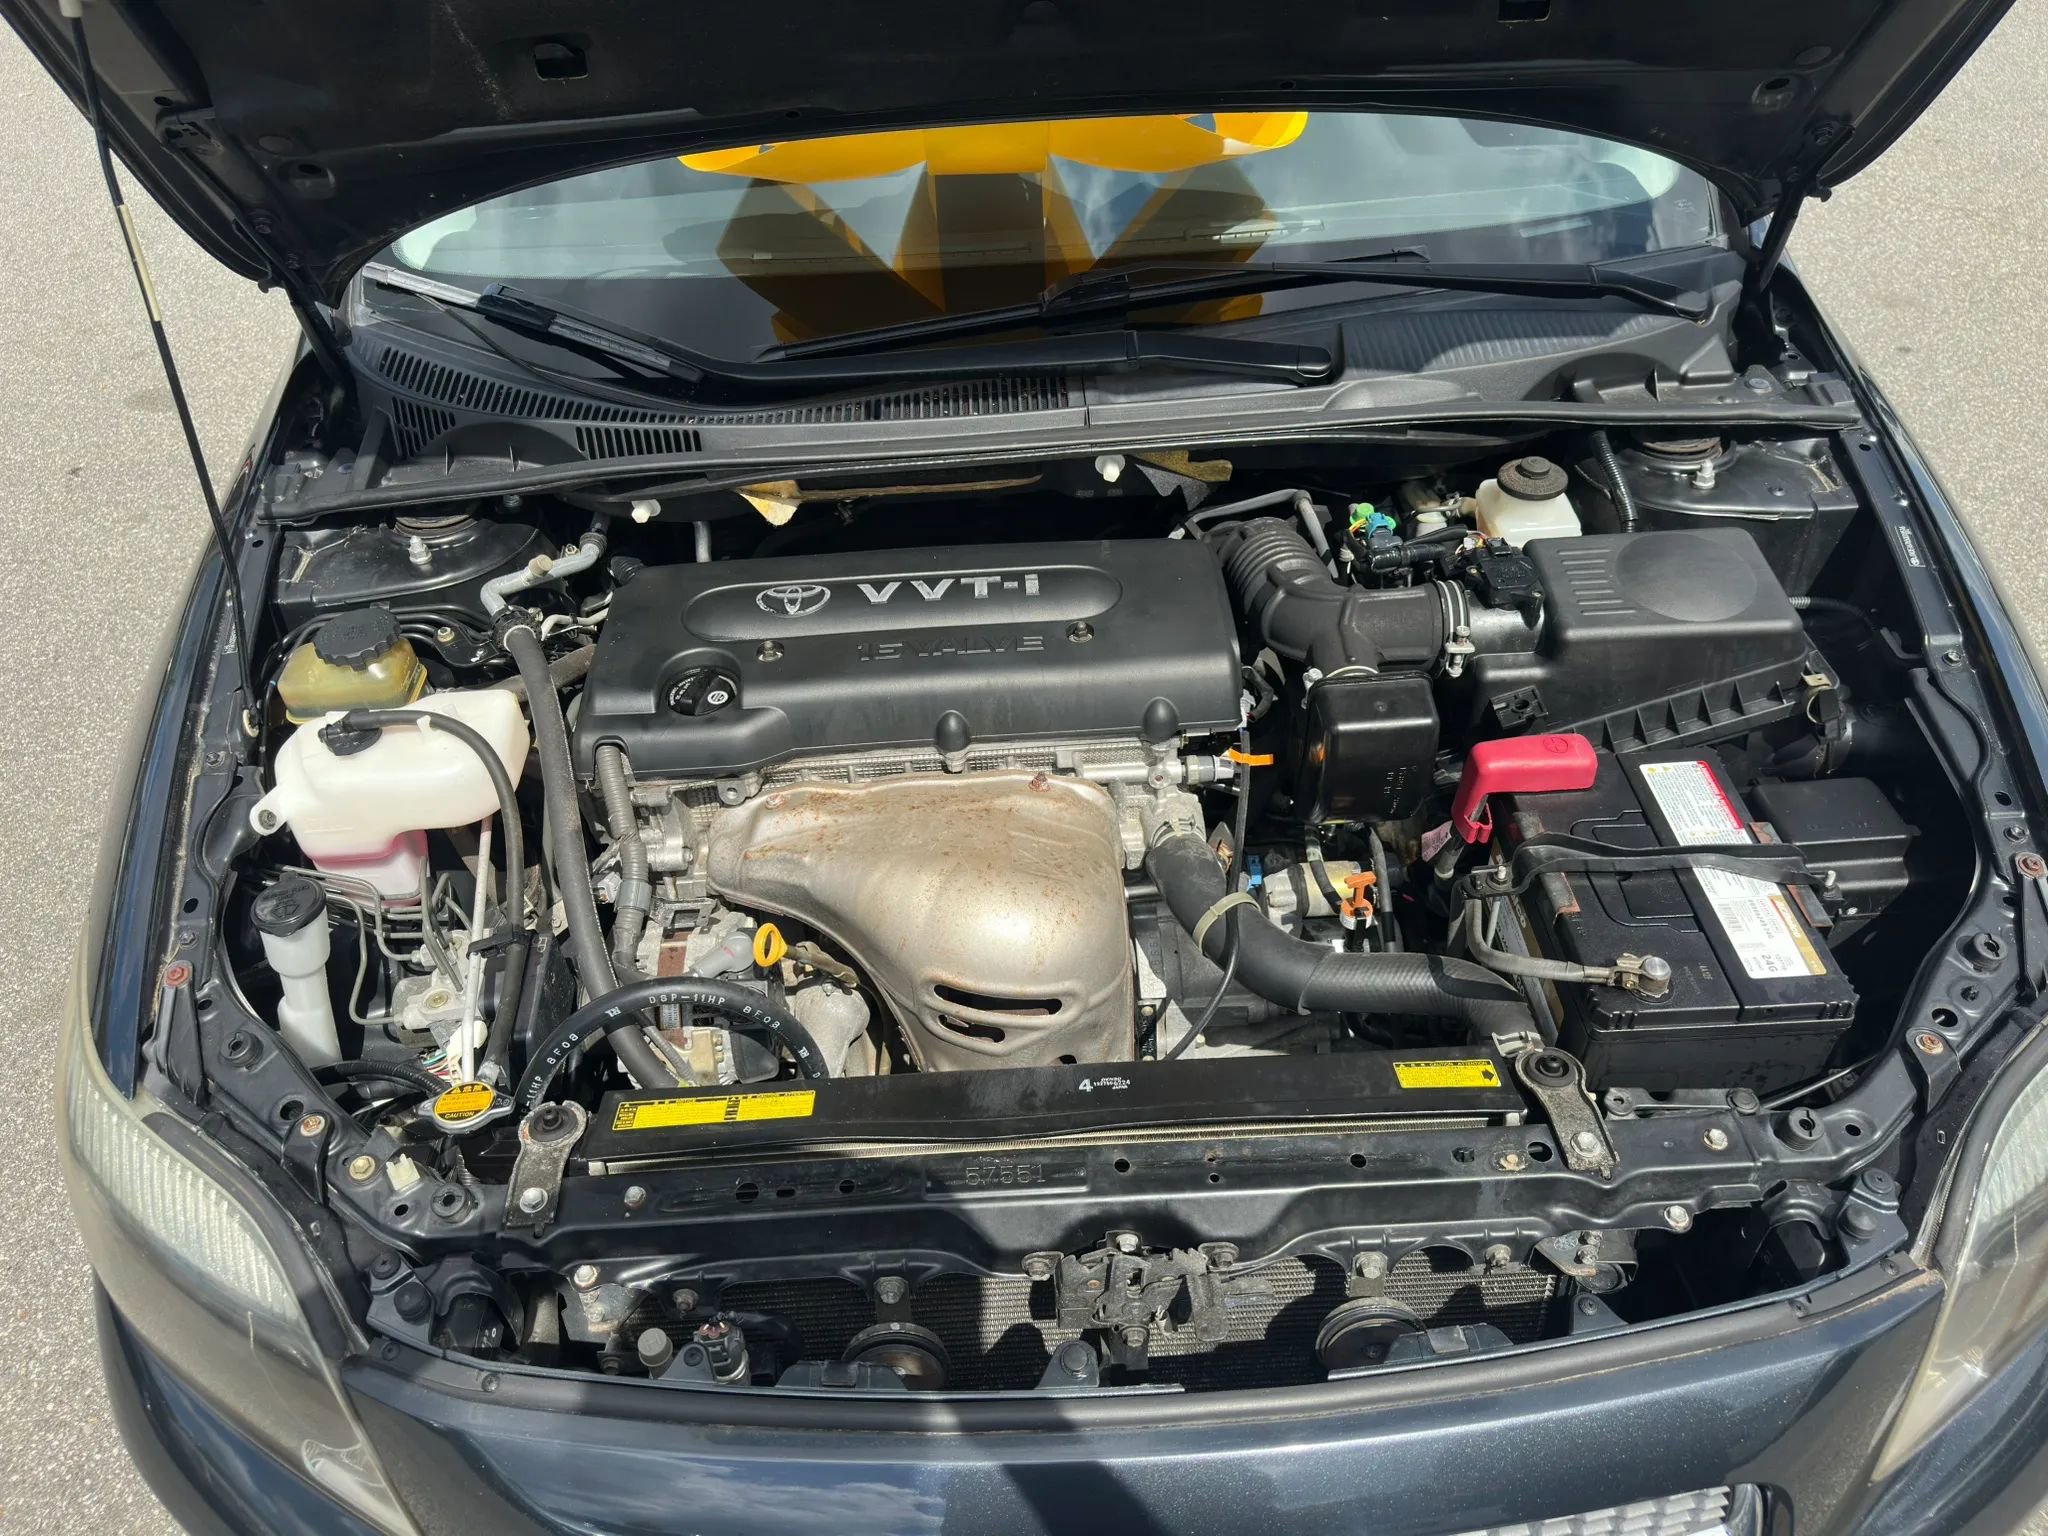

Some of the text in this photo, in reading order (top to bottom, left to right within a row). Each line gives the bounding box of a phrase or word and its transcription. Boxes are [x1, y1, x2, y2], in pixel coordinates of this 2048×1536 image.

[907, 634, 1045, 657] VALVE
[1761, 954, 1778, 972] 24G
[1078, 1079, 1093, 1092] 4
[444, 1111, 475, 1119] CAUTION
